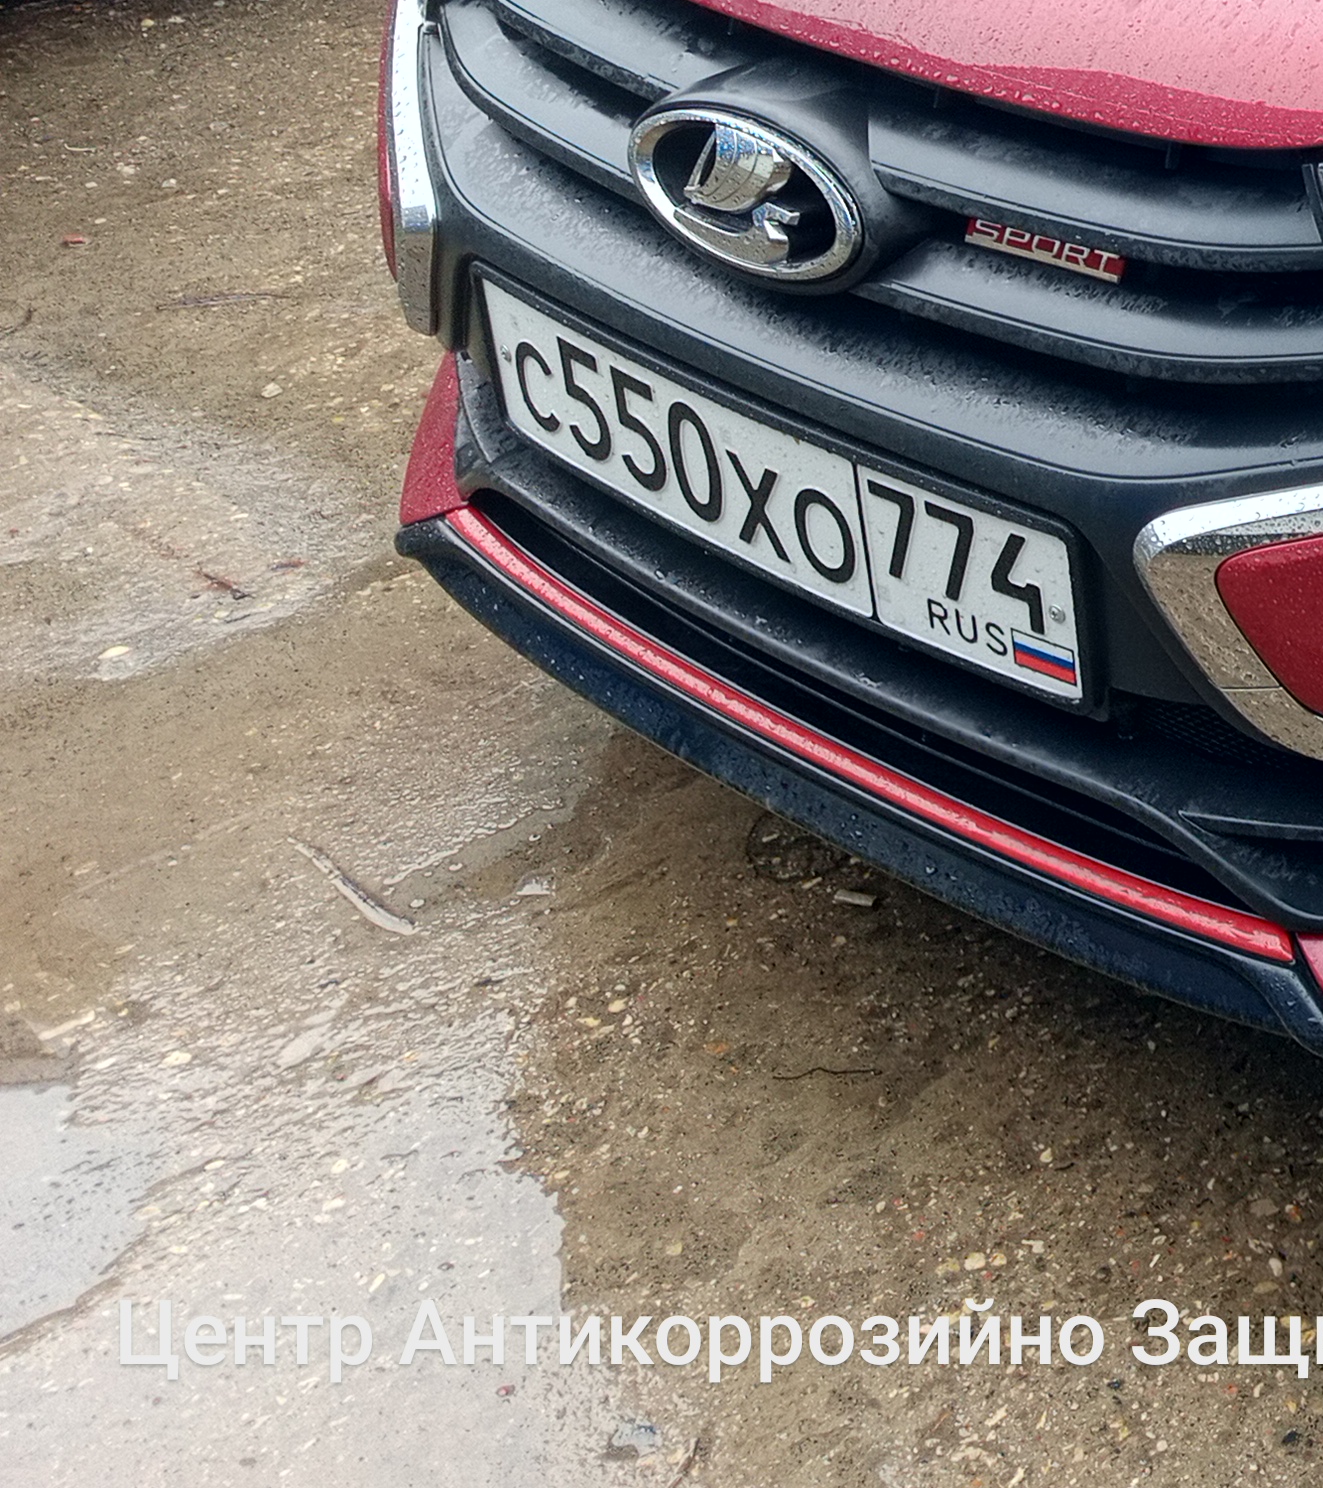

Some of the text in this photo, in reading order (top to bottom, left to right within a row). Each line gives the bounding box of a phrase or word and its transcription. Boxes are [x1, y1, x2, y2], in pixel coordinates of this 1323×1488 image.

[972, 219, 1121, 276] SPORT
[513, 335, 1046, 635] С550ХО 774
[927, 597, 1010, 658] RUS
